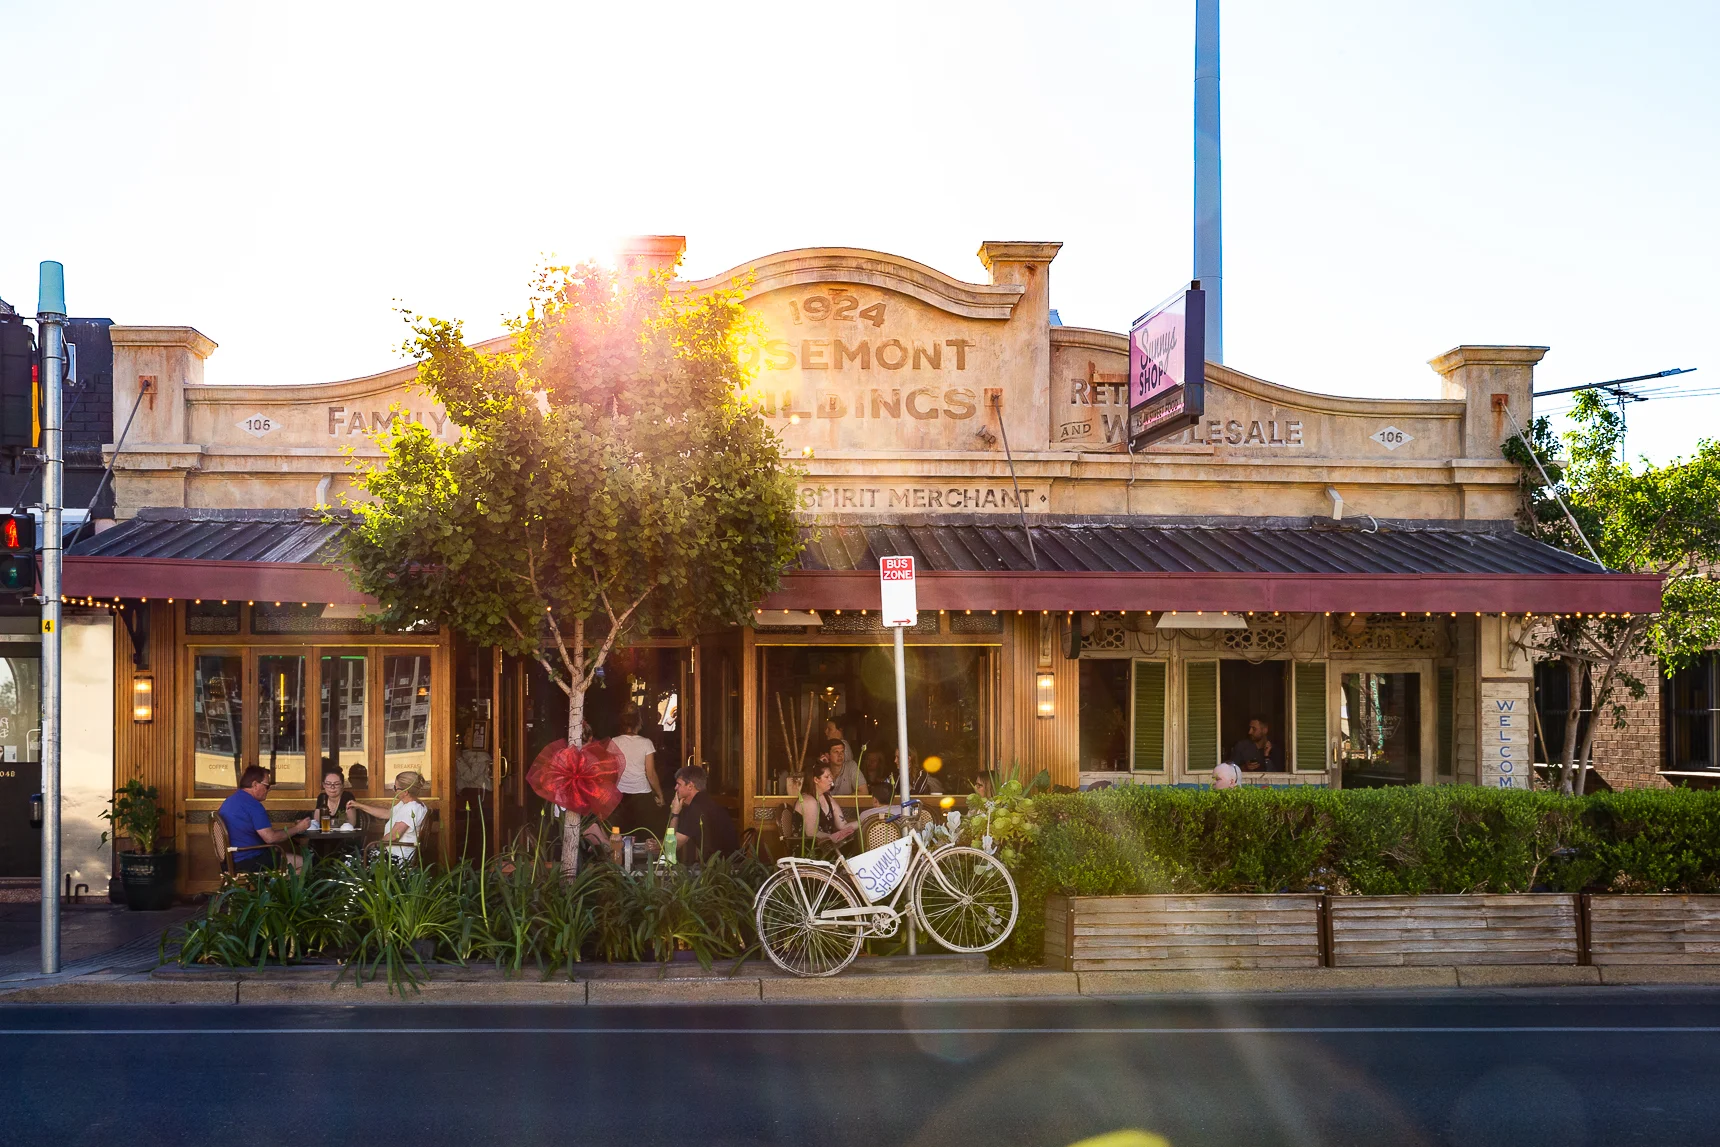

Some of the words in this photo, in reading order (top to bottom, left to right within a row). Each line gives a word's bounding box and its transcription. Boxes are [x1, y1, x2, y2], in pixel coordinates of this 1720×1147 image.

[789, 295, 887, 329] 1924
[738, 338, 976, 371] OSEMONT
[1141, 327, 1178, 374] Sunnys
[1140, 359, 1166, 396] SHOP
[751, 386, 977, 421] ILDINGS
[246, 419, 271, 431] 106
[1060, 423, 1091, 438] AND
[1380, 431, 1403, 443] 106
[800, 487, 880, 508] SPIRIT
[889, 488, 1034, 508] MERCHANT
[883, 570, 912, 580] ZONE
[886, 559, 908, 569] BUS
[44, 620, 51, 632] 4
[1496, 700, 1514, 788] WELCOM
[857, 842, 902, 890] Sunnys
[874, 865, 899, 897] SHOP
